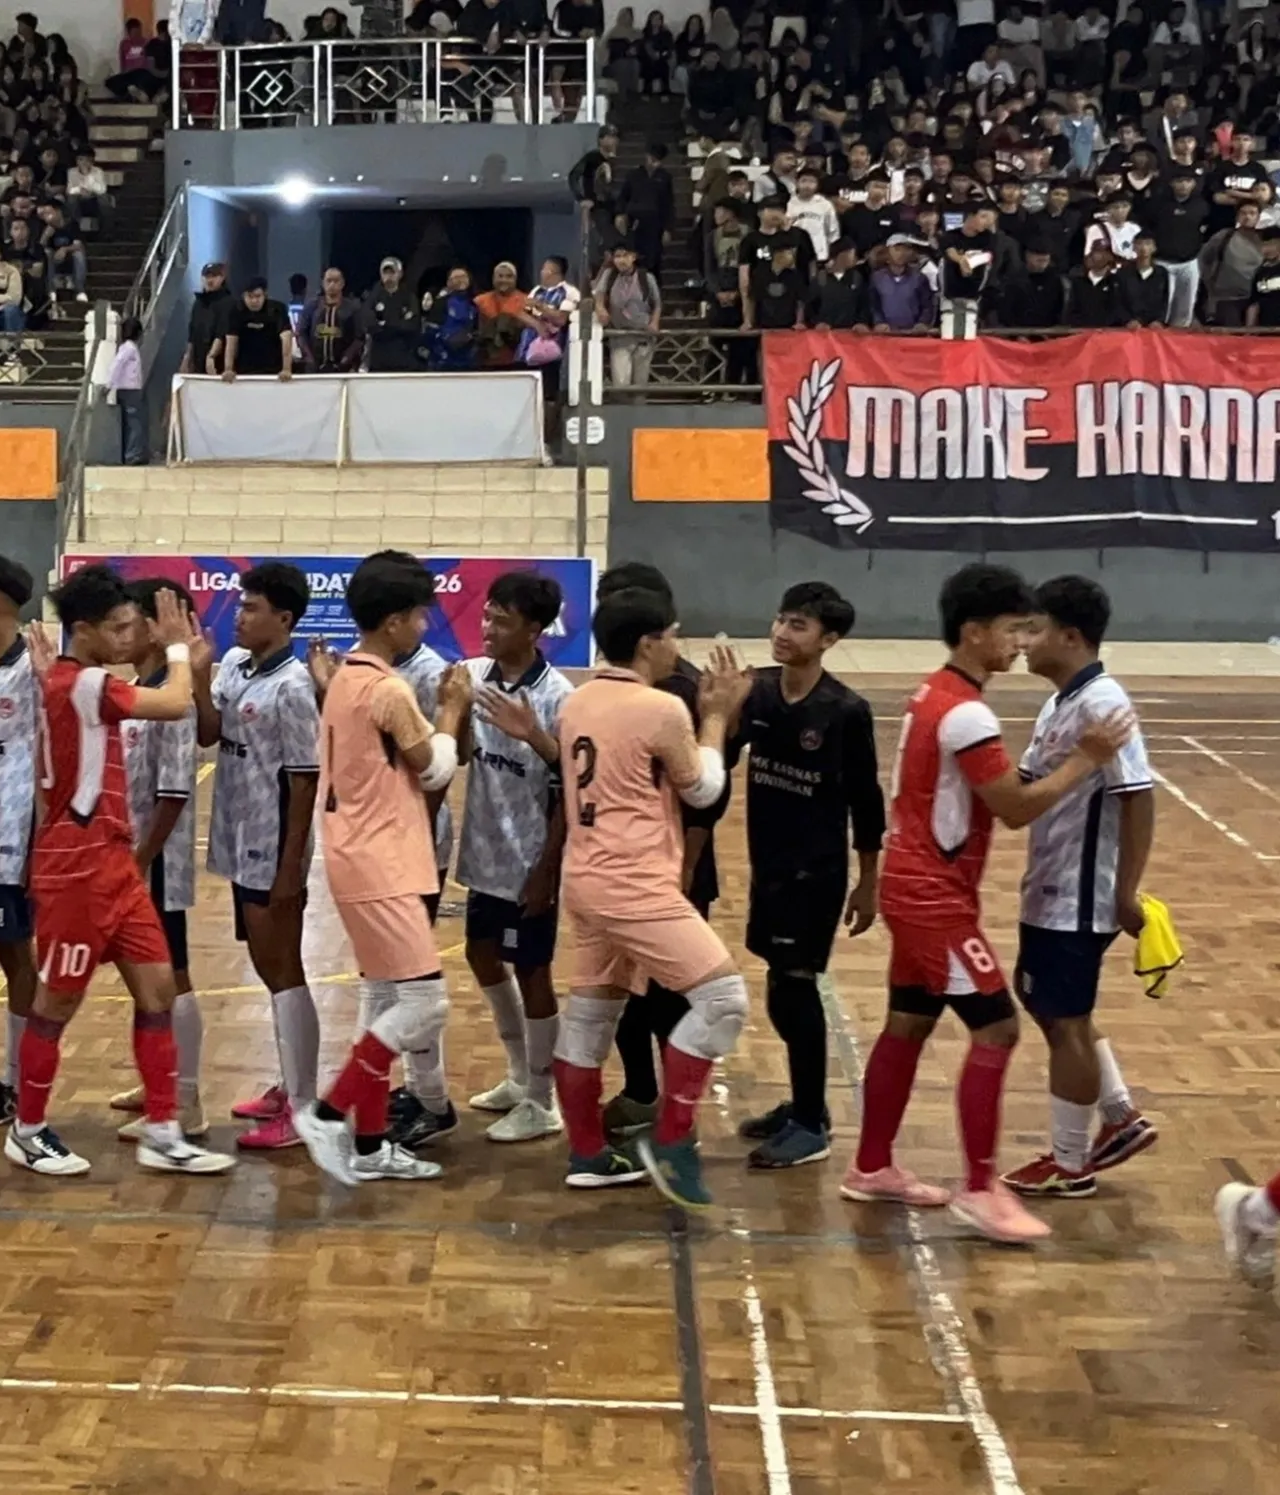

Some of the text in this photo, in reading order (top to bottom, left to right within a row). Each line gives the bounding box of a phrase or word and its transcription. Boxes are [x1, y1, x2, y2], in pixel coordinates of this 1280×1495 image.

[845, 384, 1050, 482] MAKE
[189, 572, 462, 593] LIGA 26
[59, 942, 91, 977] 10
[962, 937, 995, 973] 8
